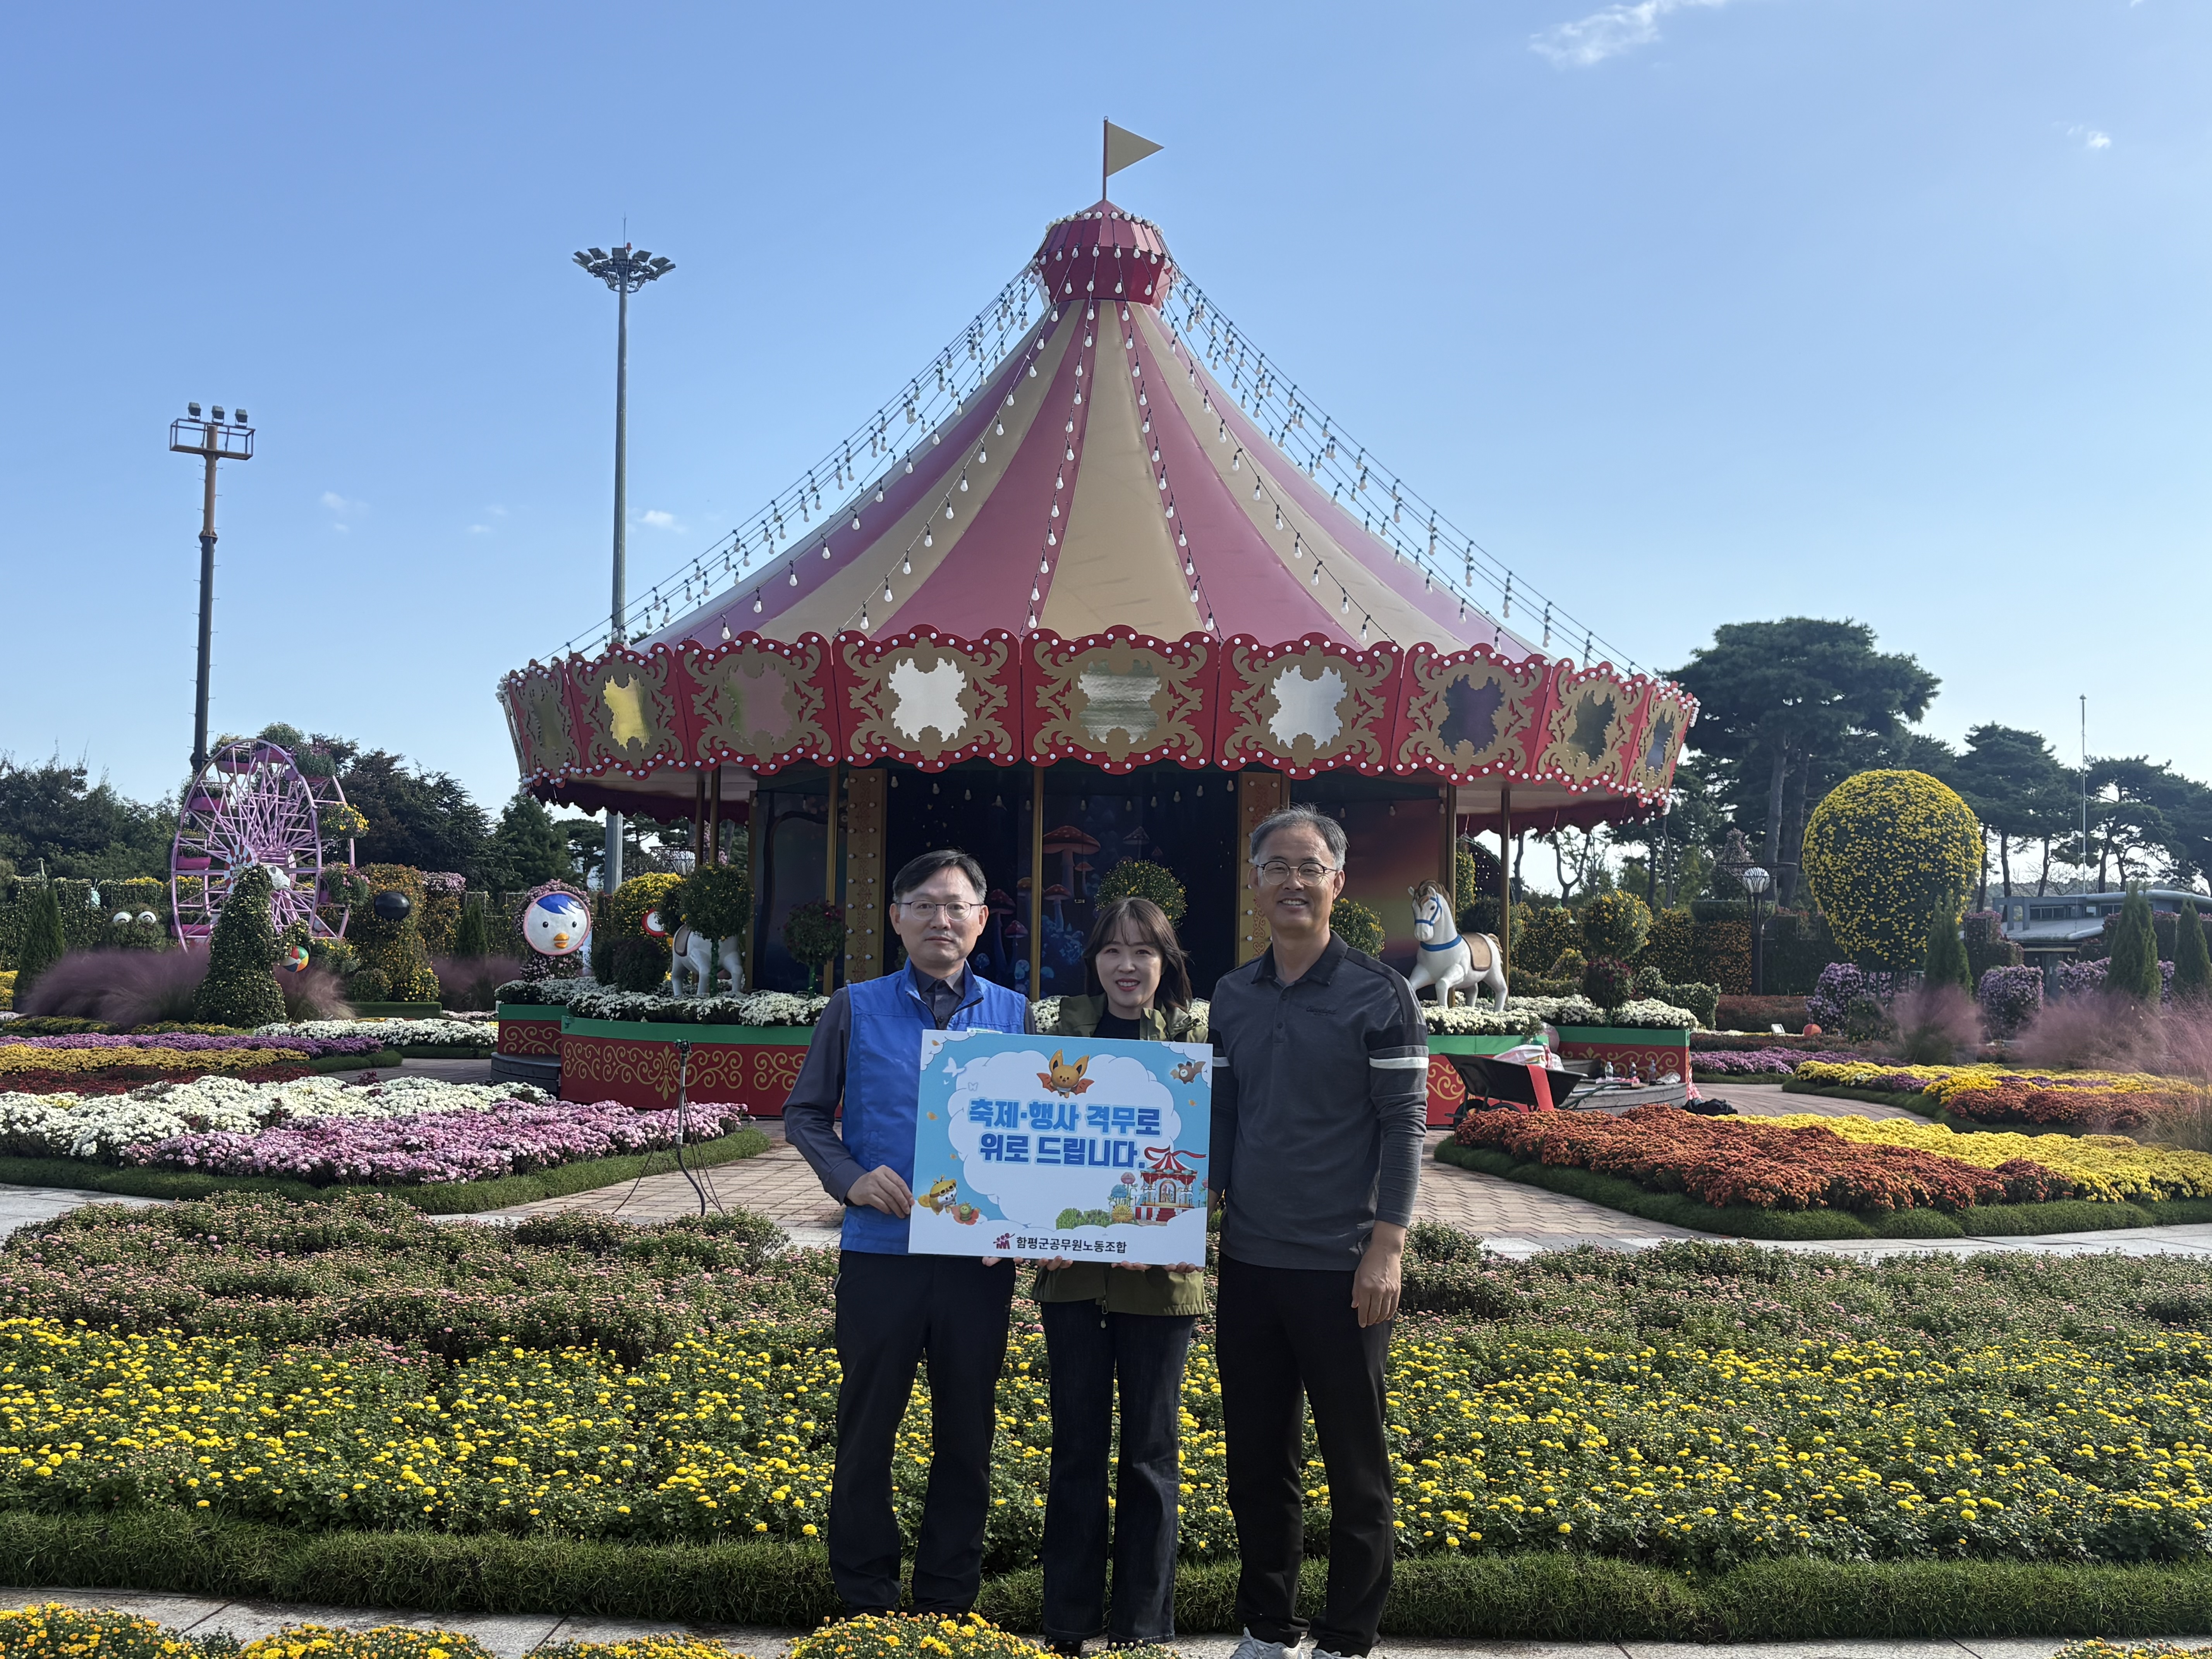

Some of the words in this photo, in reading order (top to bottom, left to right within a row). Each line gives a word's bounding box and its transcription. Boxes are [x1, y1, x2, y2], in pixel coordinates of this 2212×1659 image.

[969, 1099, 1080, 1131] 축제·행사
[1087, 1106, 1161, 1135] 격무로
[980, 1133, 1029, 1162] 위로
[1037, 1136, 1146, 1169] 드립니다.
[1016, 1236, 1127, 1254] 함평군공무원노동조합
